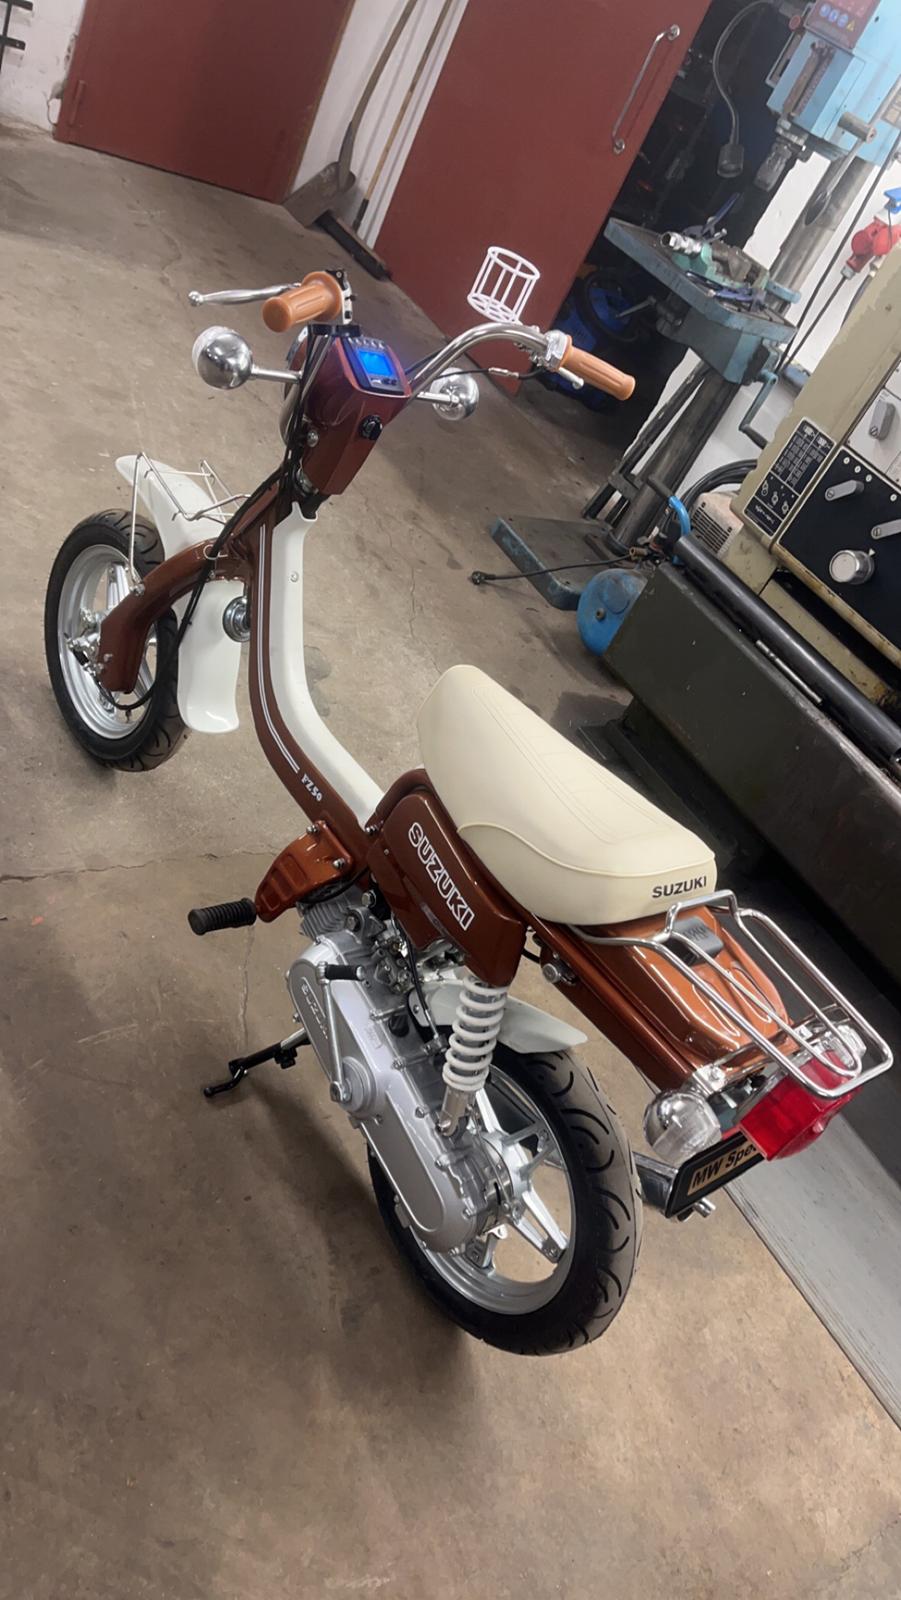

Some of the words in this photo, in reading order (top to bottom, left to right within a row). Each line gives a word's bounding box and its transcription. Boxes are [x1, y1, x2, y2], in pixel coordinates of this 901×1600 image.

[301, 772, 322, 801] FZ50
[408, 822, 475, 931] SUZUKI
[652, 876, 707, 898] SUZUKI
[692, 1158, 723, 1188] MW
